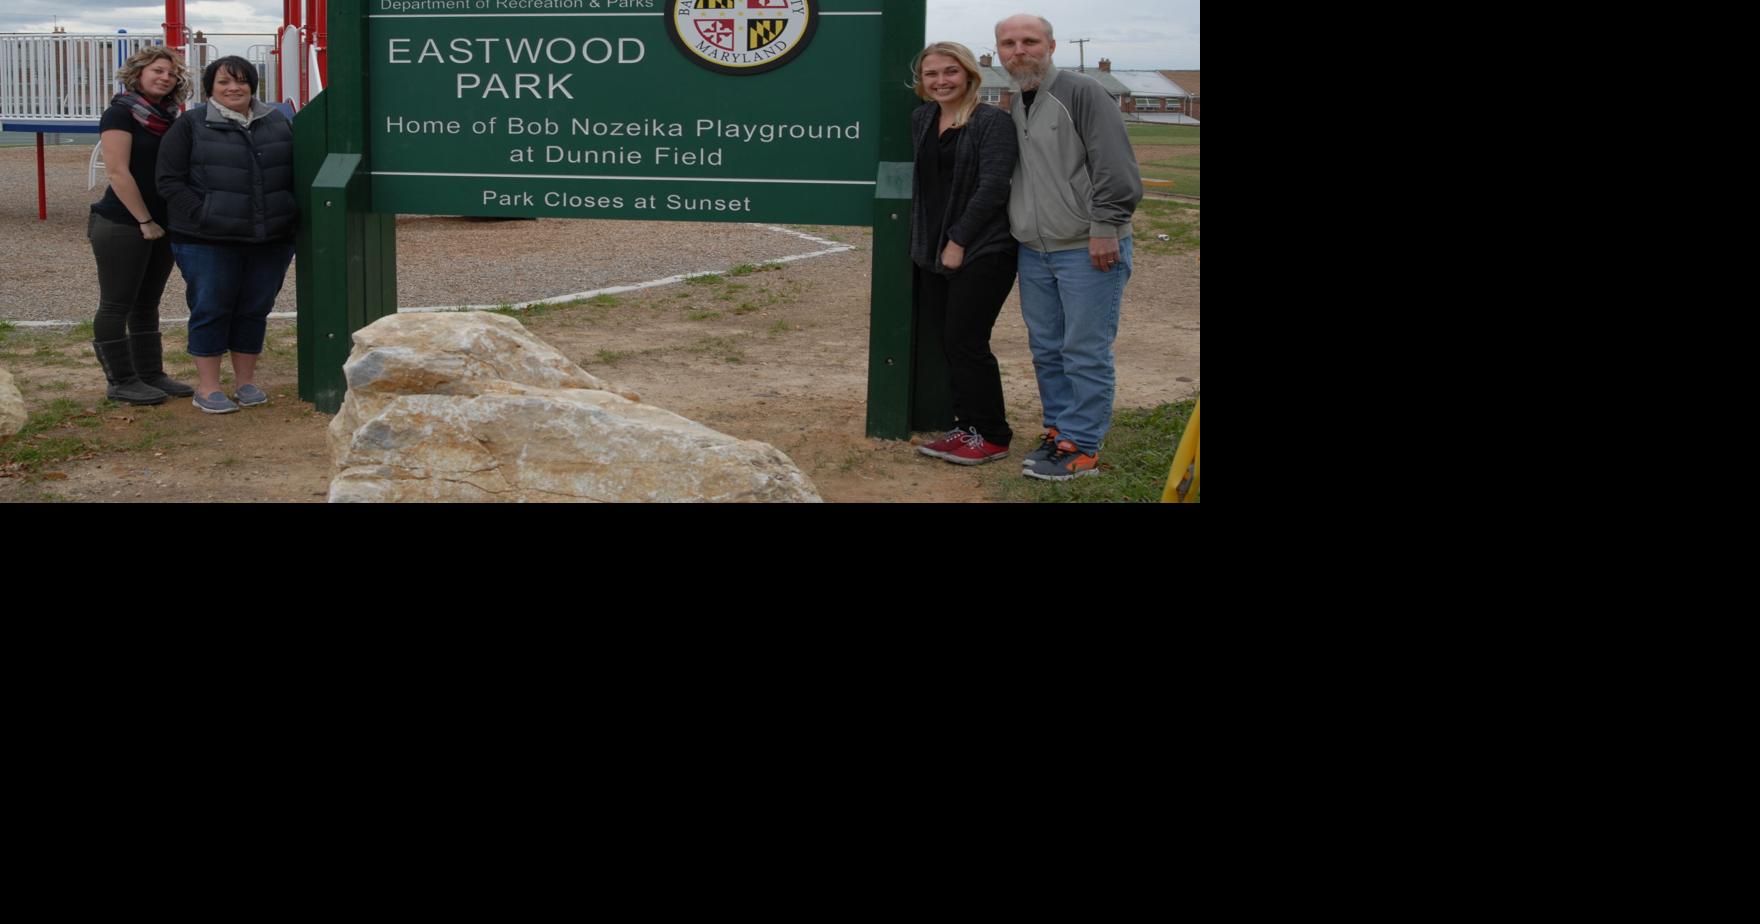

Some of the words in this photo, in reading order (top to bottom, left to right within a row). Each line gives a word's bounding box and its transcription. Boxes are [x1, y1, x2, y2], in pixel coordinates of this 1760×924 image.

[381, 0, 469, 12] Department
[475, 0, 489, 9] of
[496, 0, 583, 9] Recreation
[589, 0, 601, 8] &
[607, 0, 654, 8] Parks
[388, 37, 646, 65] EASTWOOD
[695, 40, 788, 64] MARYLAND
[455, 73, 575, 100] PARK
[386, 116, 461, 135] Home
[472, 116, 497, 135] of
[508, 117, 559, 136] Bob
[571, 118, 683, 138] Nozeika
[696, 118, 861, 143] Playground
[509, 145, 534, 164] at
[546, 145, 643, 166] Dunnie
[655, 146, 723, 167] Field
[482, 190, 534, 207] Park
[544, 190, 624, 209] Closes
[634, 194, 656, 210] at
[666, 194, 752, 212] Sunset
